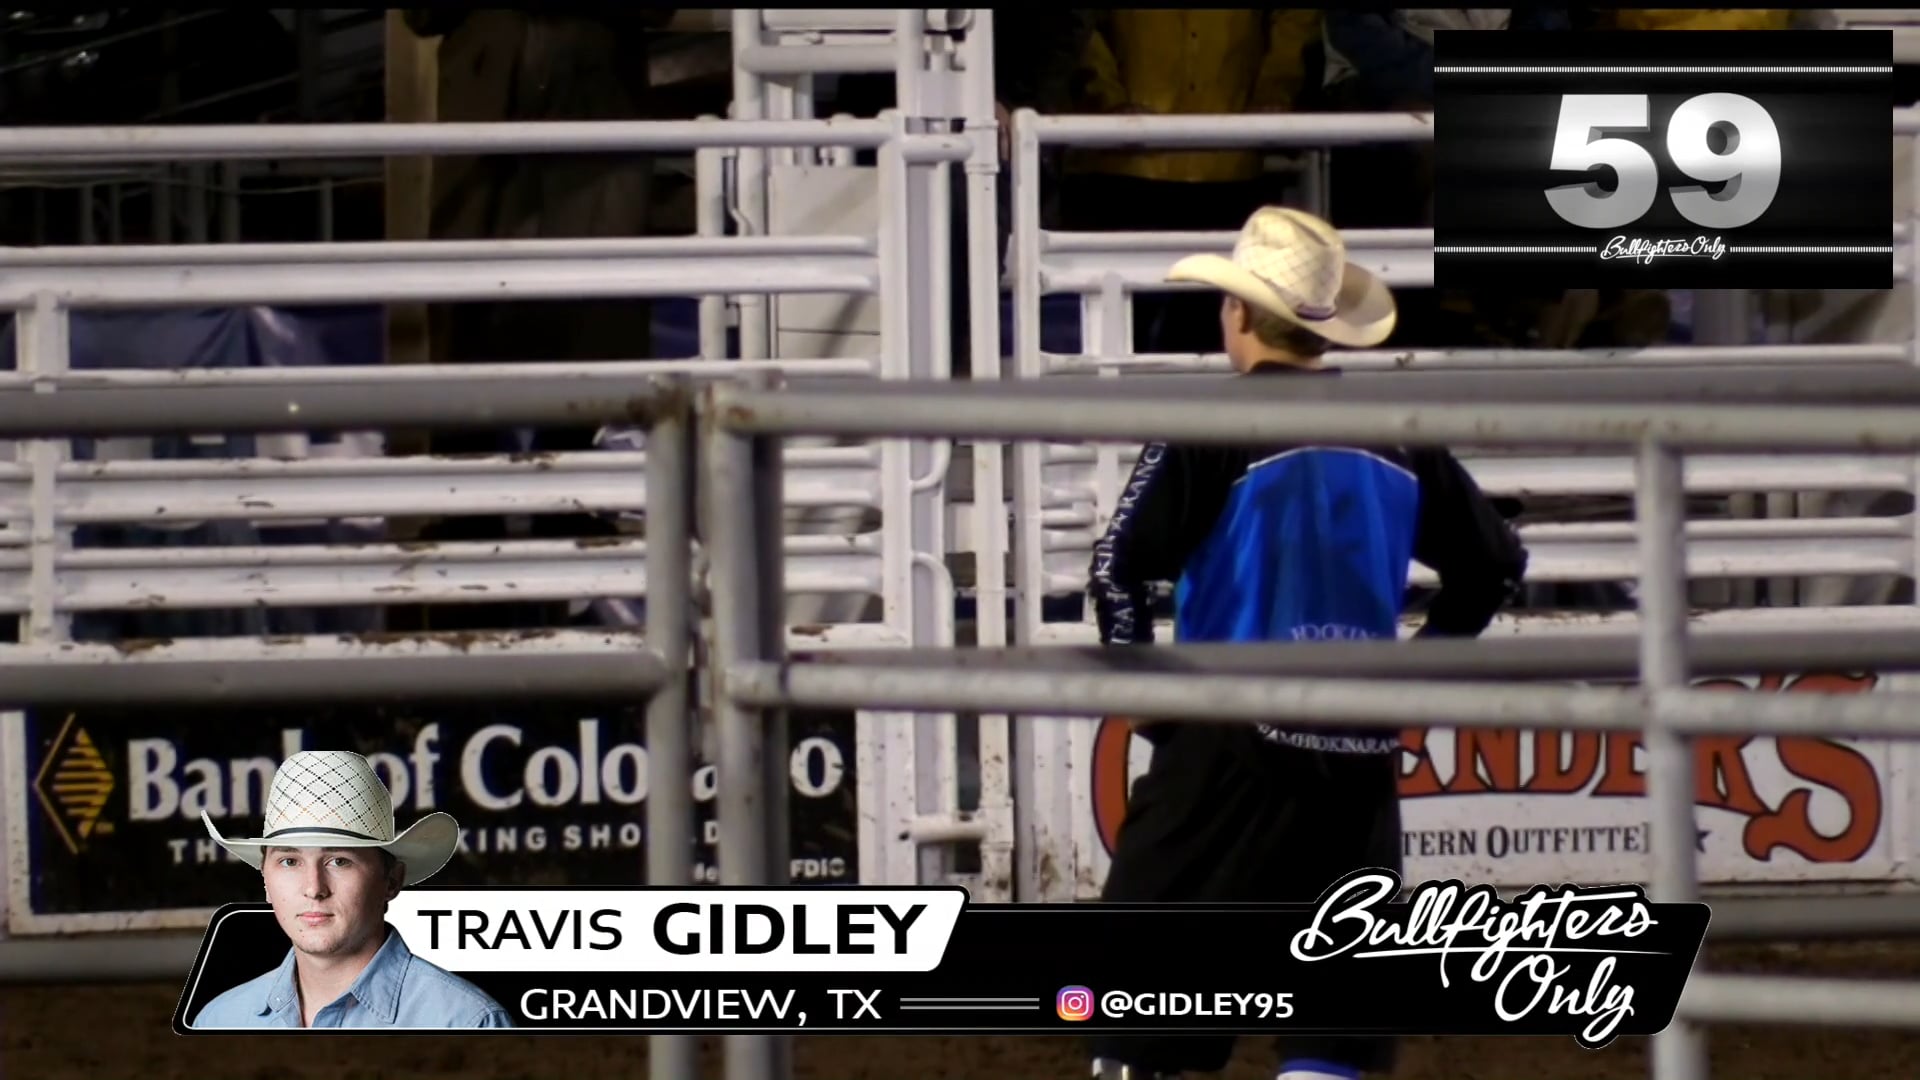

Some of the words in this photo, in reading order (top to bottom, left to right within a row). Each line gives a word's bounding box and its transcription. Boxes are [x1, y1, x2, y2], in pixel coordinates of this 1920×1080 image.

[127, 729, 304, 822] Ban
[460, 718, 844, 812] Coloao
[458, 827, 547, 855] KING
[1401, 829, 1476, 858] TERN
[1486, 822, 1652, 858] OUTFITTE
[790, 857, 845, 879] FDIC
